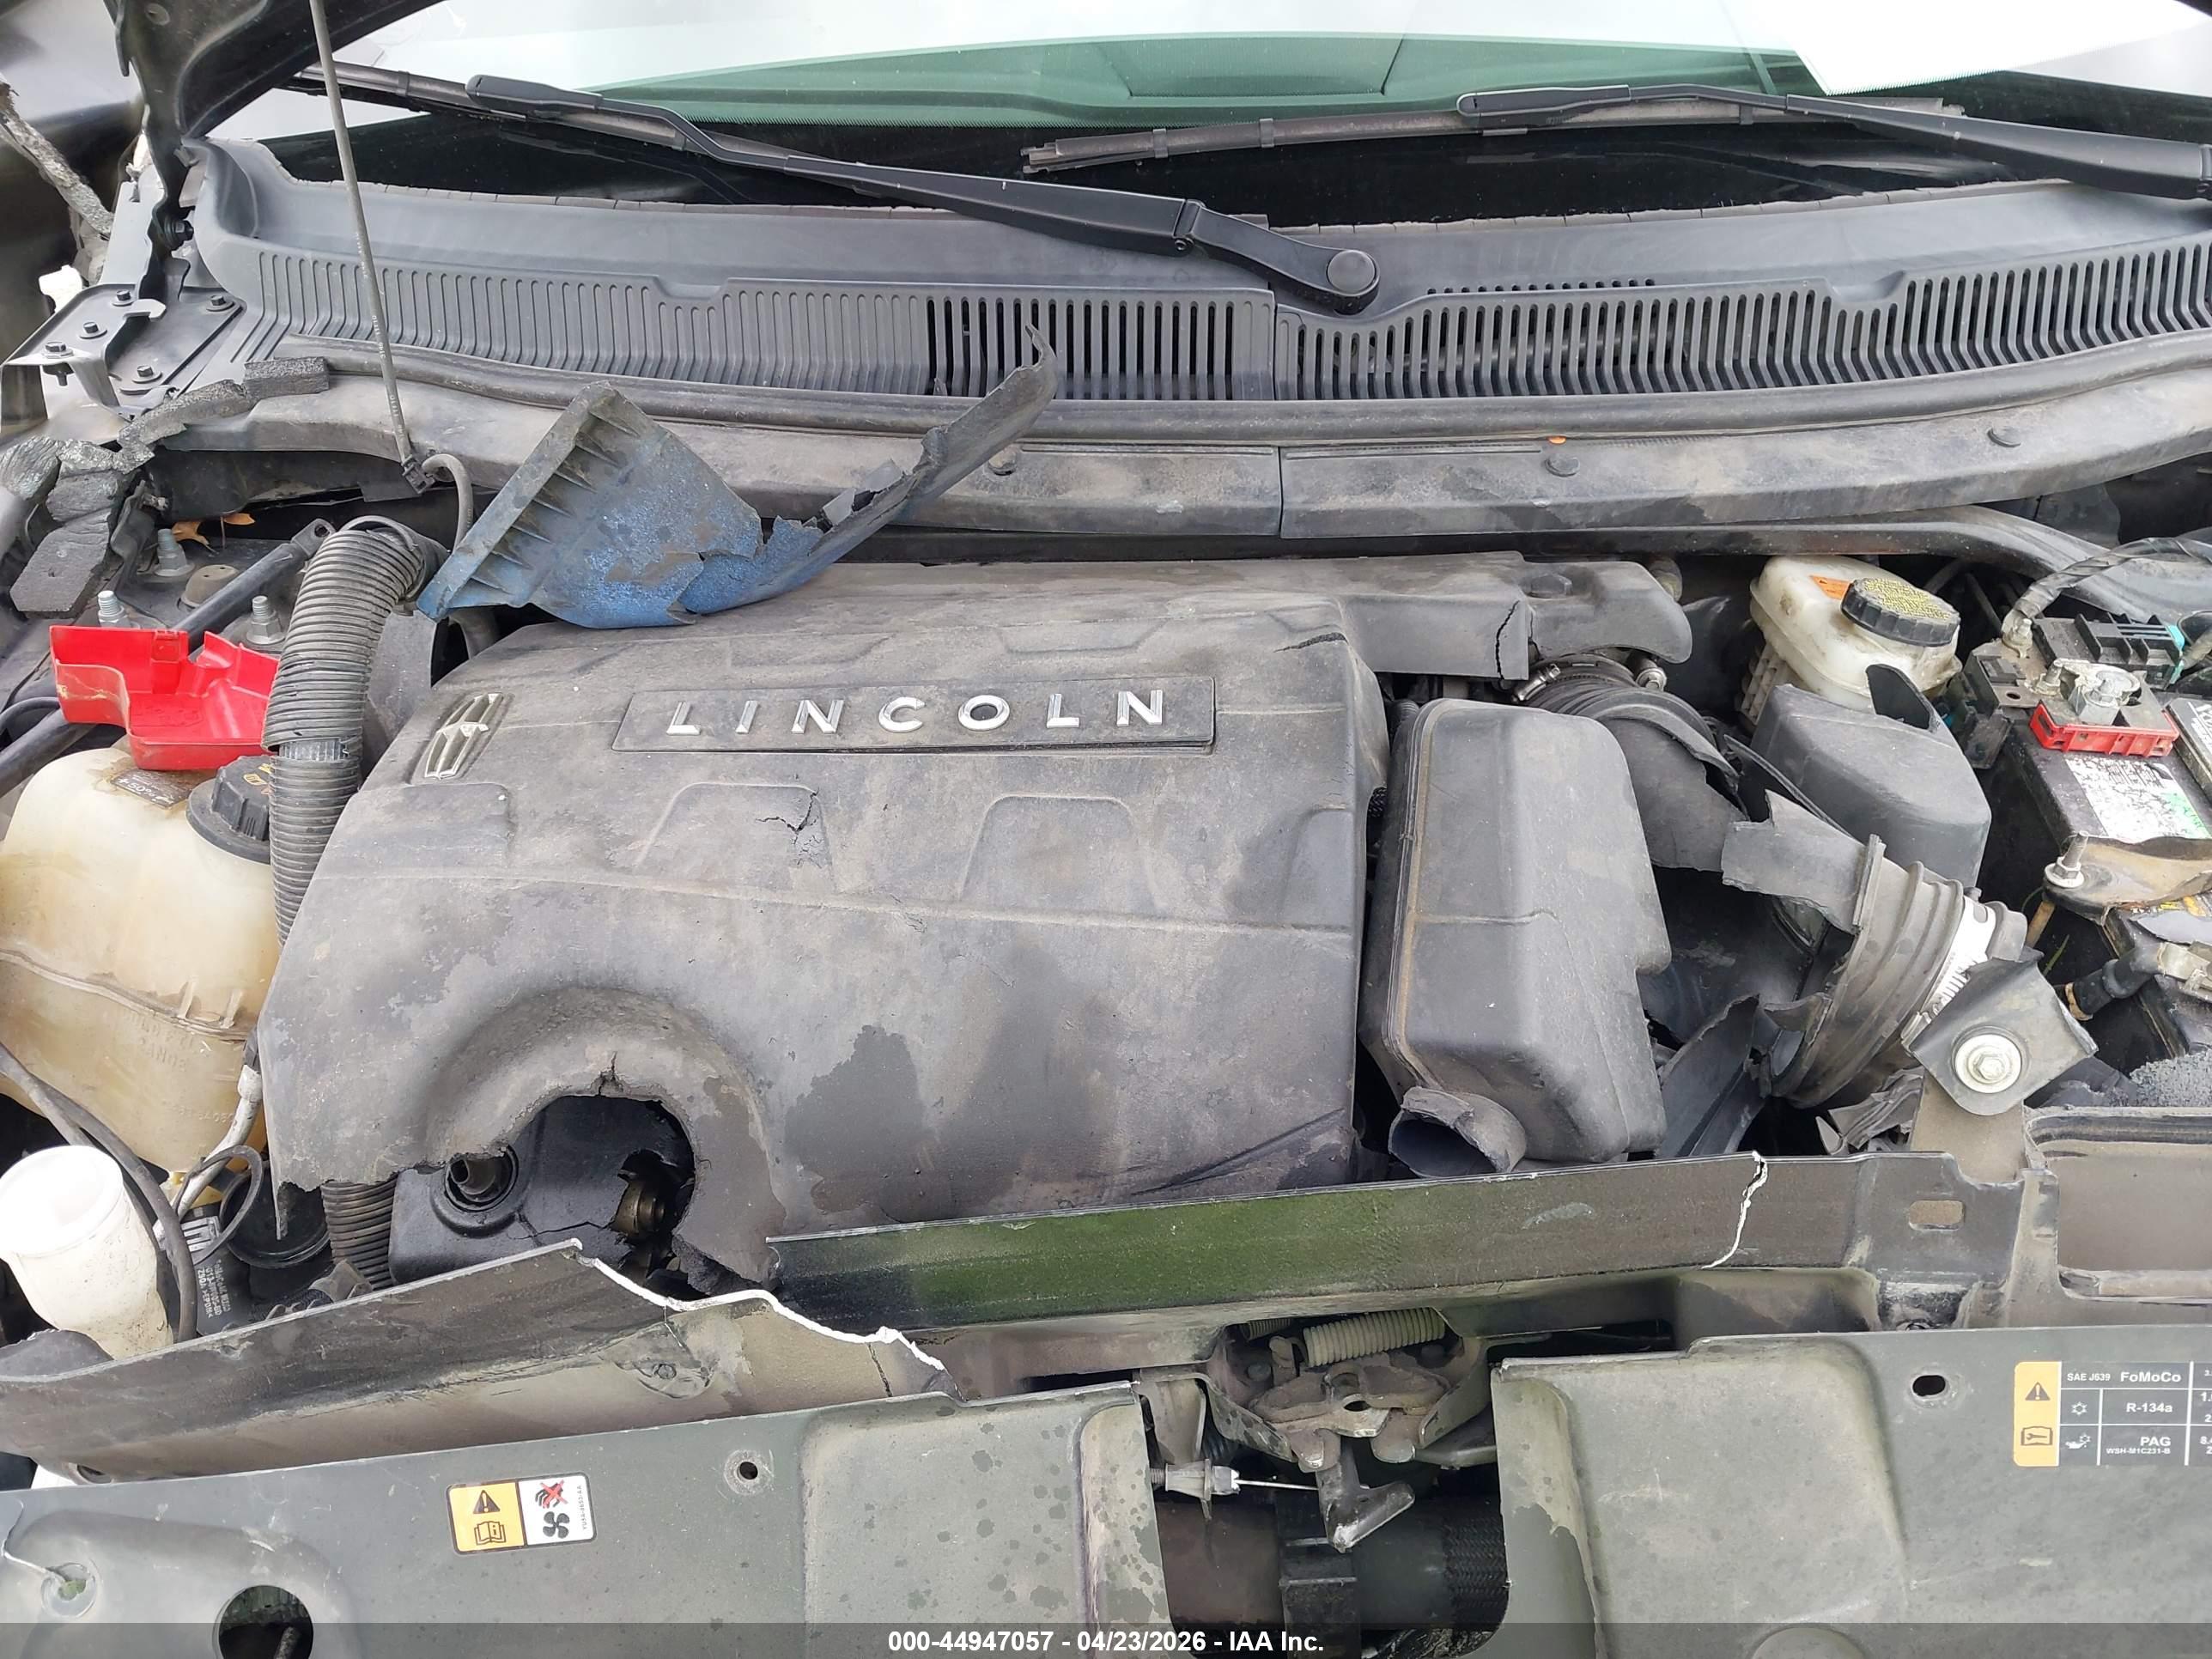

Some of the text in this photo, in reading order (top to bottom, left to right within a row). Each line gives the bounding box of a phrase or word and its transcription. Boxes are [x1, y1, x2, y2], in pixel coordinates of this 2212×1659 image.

[665, 690, 1164, 736] LINCOLN
[2067, 1371, 2182, 1382] SAE J639 FoMoCo
[2125, 1402, 2173, 1413] R-134a
[2140, 1436, 2172, 1447] PAG
